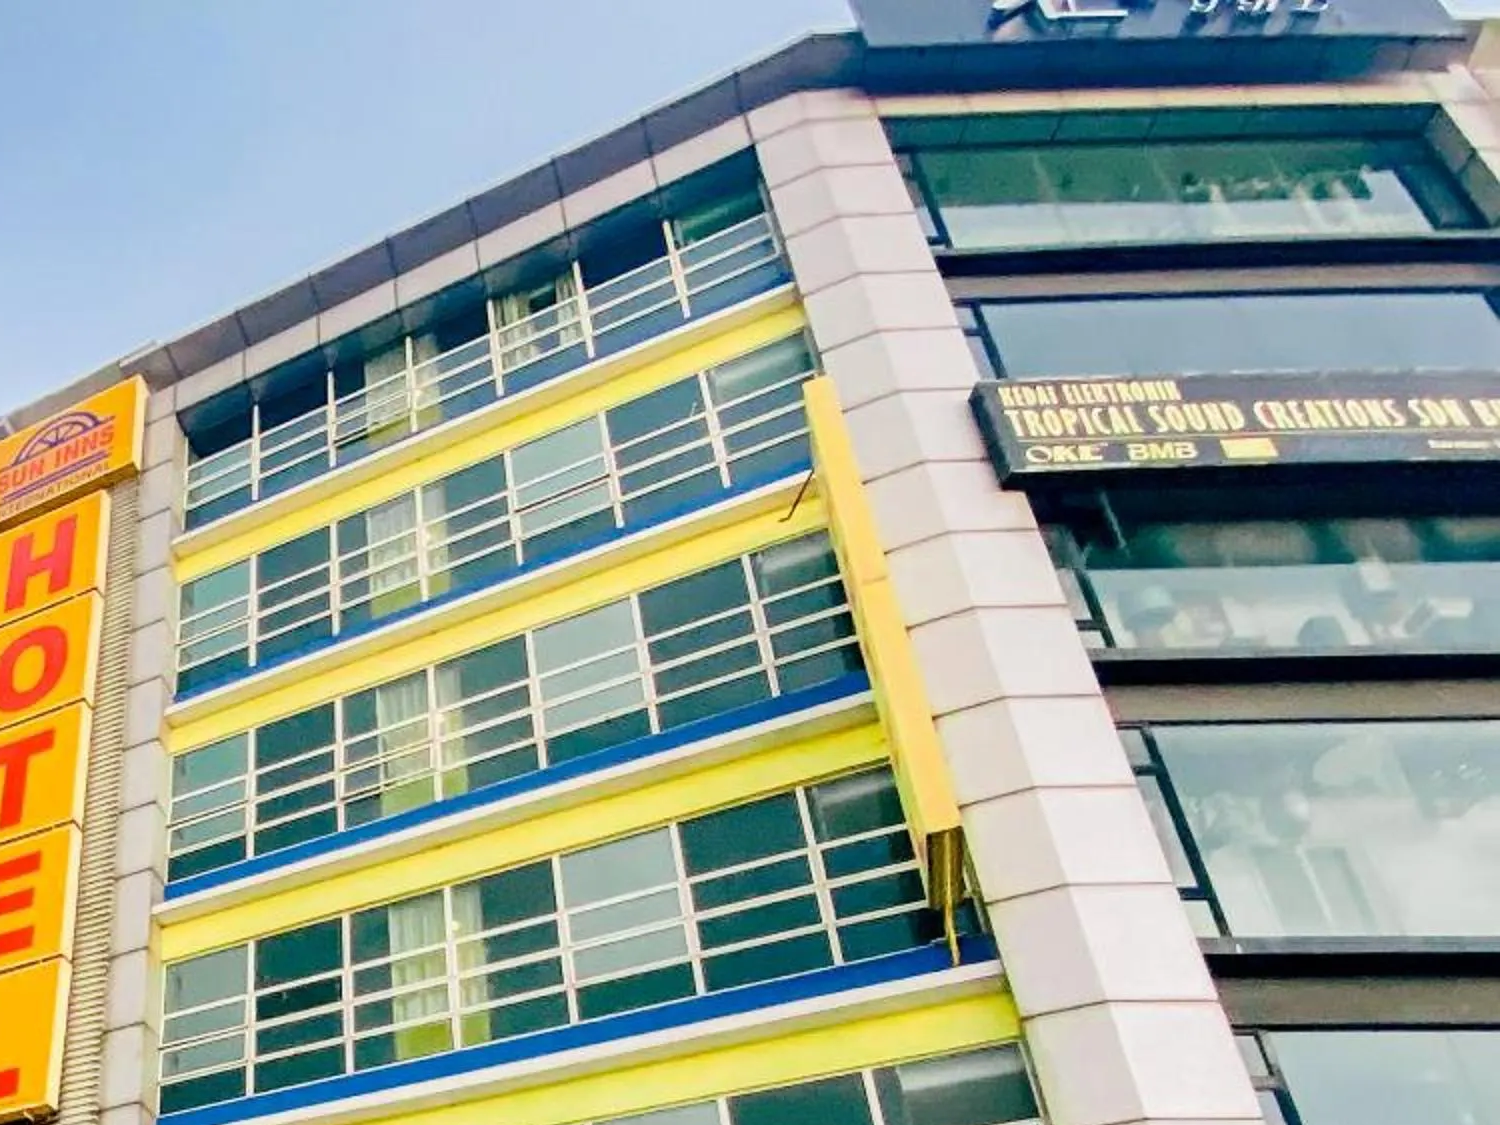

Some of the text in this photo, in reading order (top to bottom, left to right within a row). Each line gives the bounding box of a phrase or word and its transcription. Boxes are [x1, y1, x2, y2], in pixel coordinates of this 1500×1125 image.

[998, 380, 1182, 407] KEDAI ELEKTRONIK
[1004, 405, 1145, 437] TROPICAL
[1147, 401, 1246, 433] SOUND
[1253, 398, 1407, 429] CREATIONS
[1407, 398, 1471, 427] SDN
[55, 422, 115, 470] INNS
[1126, 441, 1199, 461] BMB
